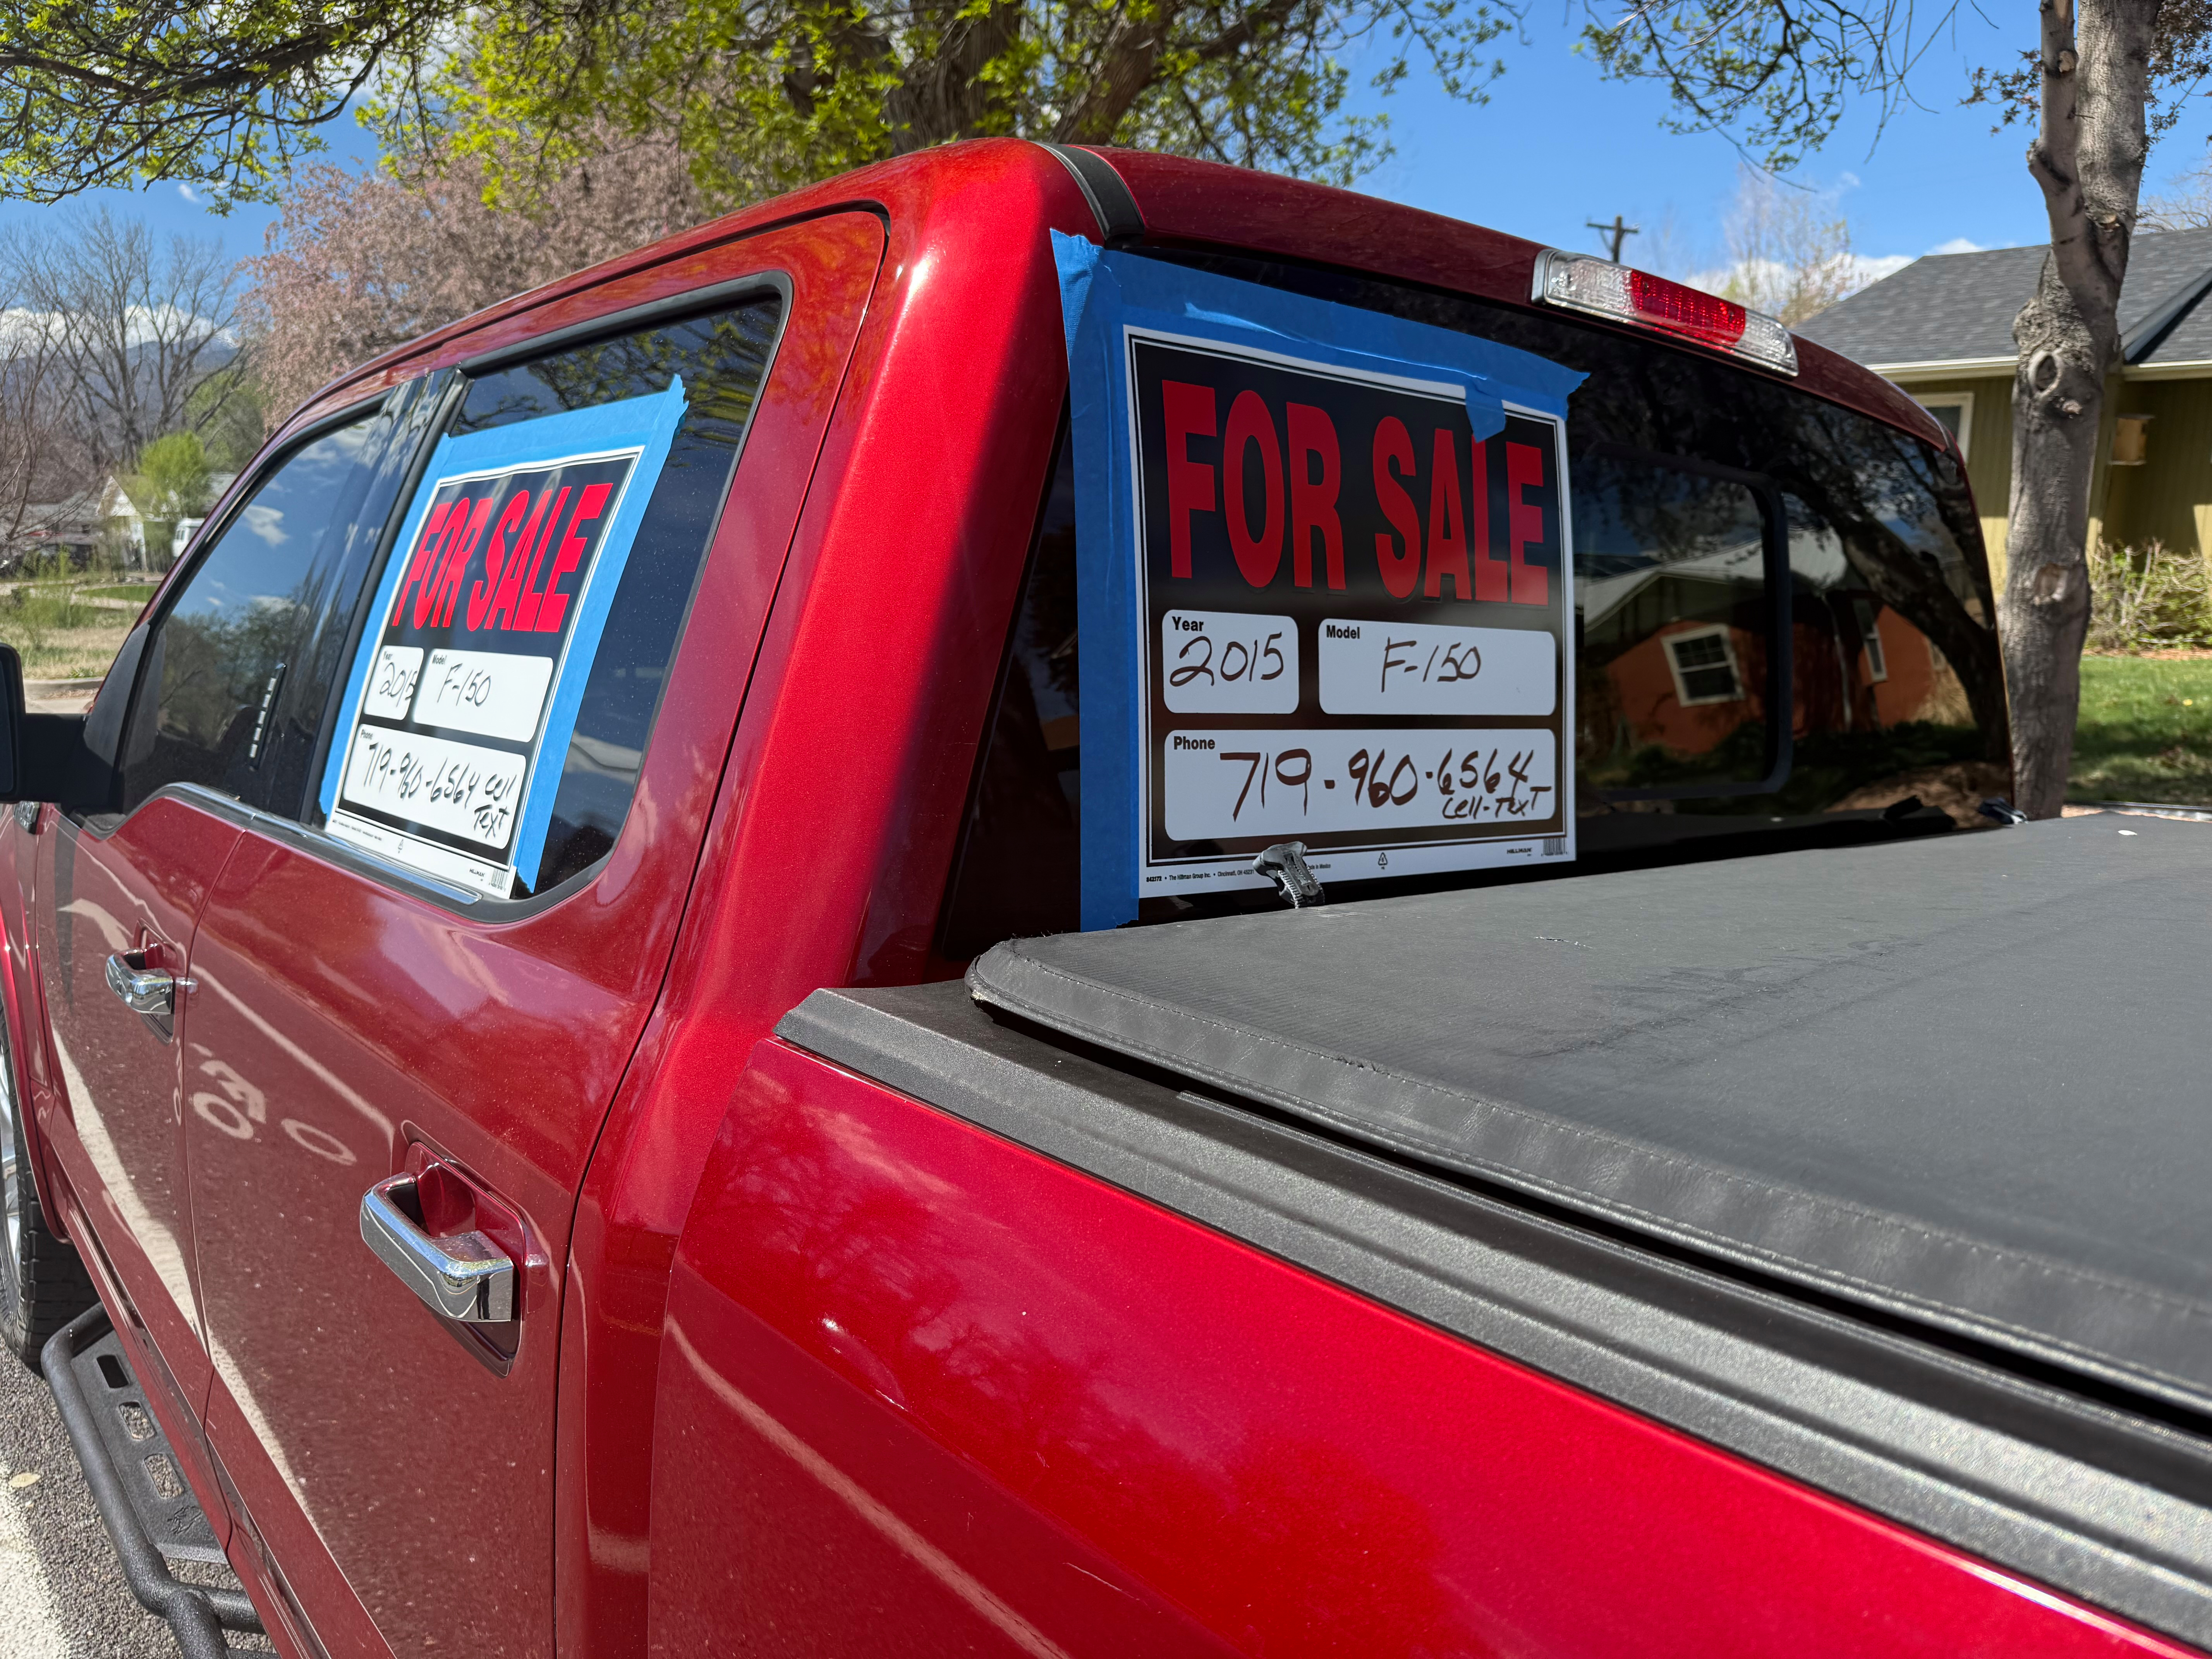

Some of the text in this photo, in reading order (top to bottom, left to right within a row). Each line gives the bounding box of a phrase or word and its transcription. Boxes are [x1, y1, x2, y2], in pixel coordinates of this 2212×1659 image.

[1162, 380, 1548, 606] FOR SALE
[392, 483, 613, 633] FOR SALE
[1172, 616, 1204, 632] Year
[1326, 625, 1360, 639] Model
[383, 651, 393, 660] Year
[432, 654, 447, 665] Model
[1170, 632, 1284, 686] 2015
[1381, 637, 1481, 693] F-150
[380, 662, 417, 708] 2015
[437, 663, 491, 707] F-150
[361, 729, 374, 740] Phone
[1173, 736, 1216, 750] Phone
[364, 742, 480, 809] 719-960-6564
